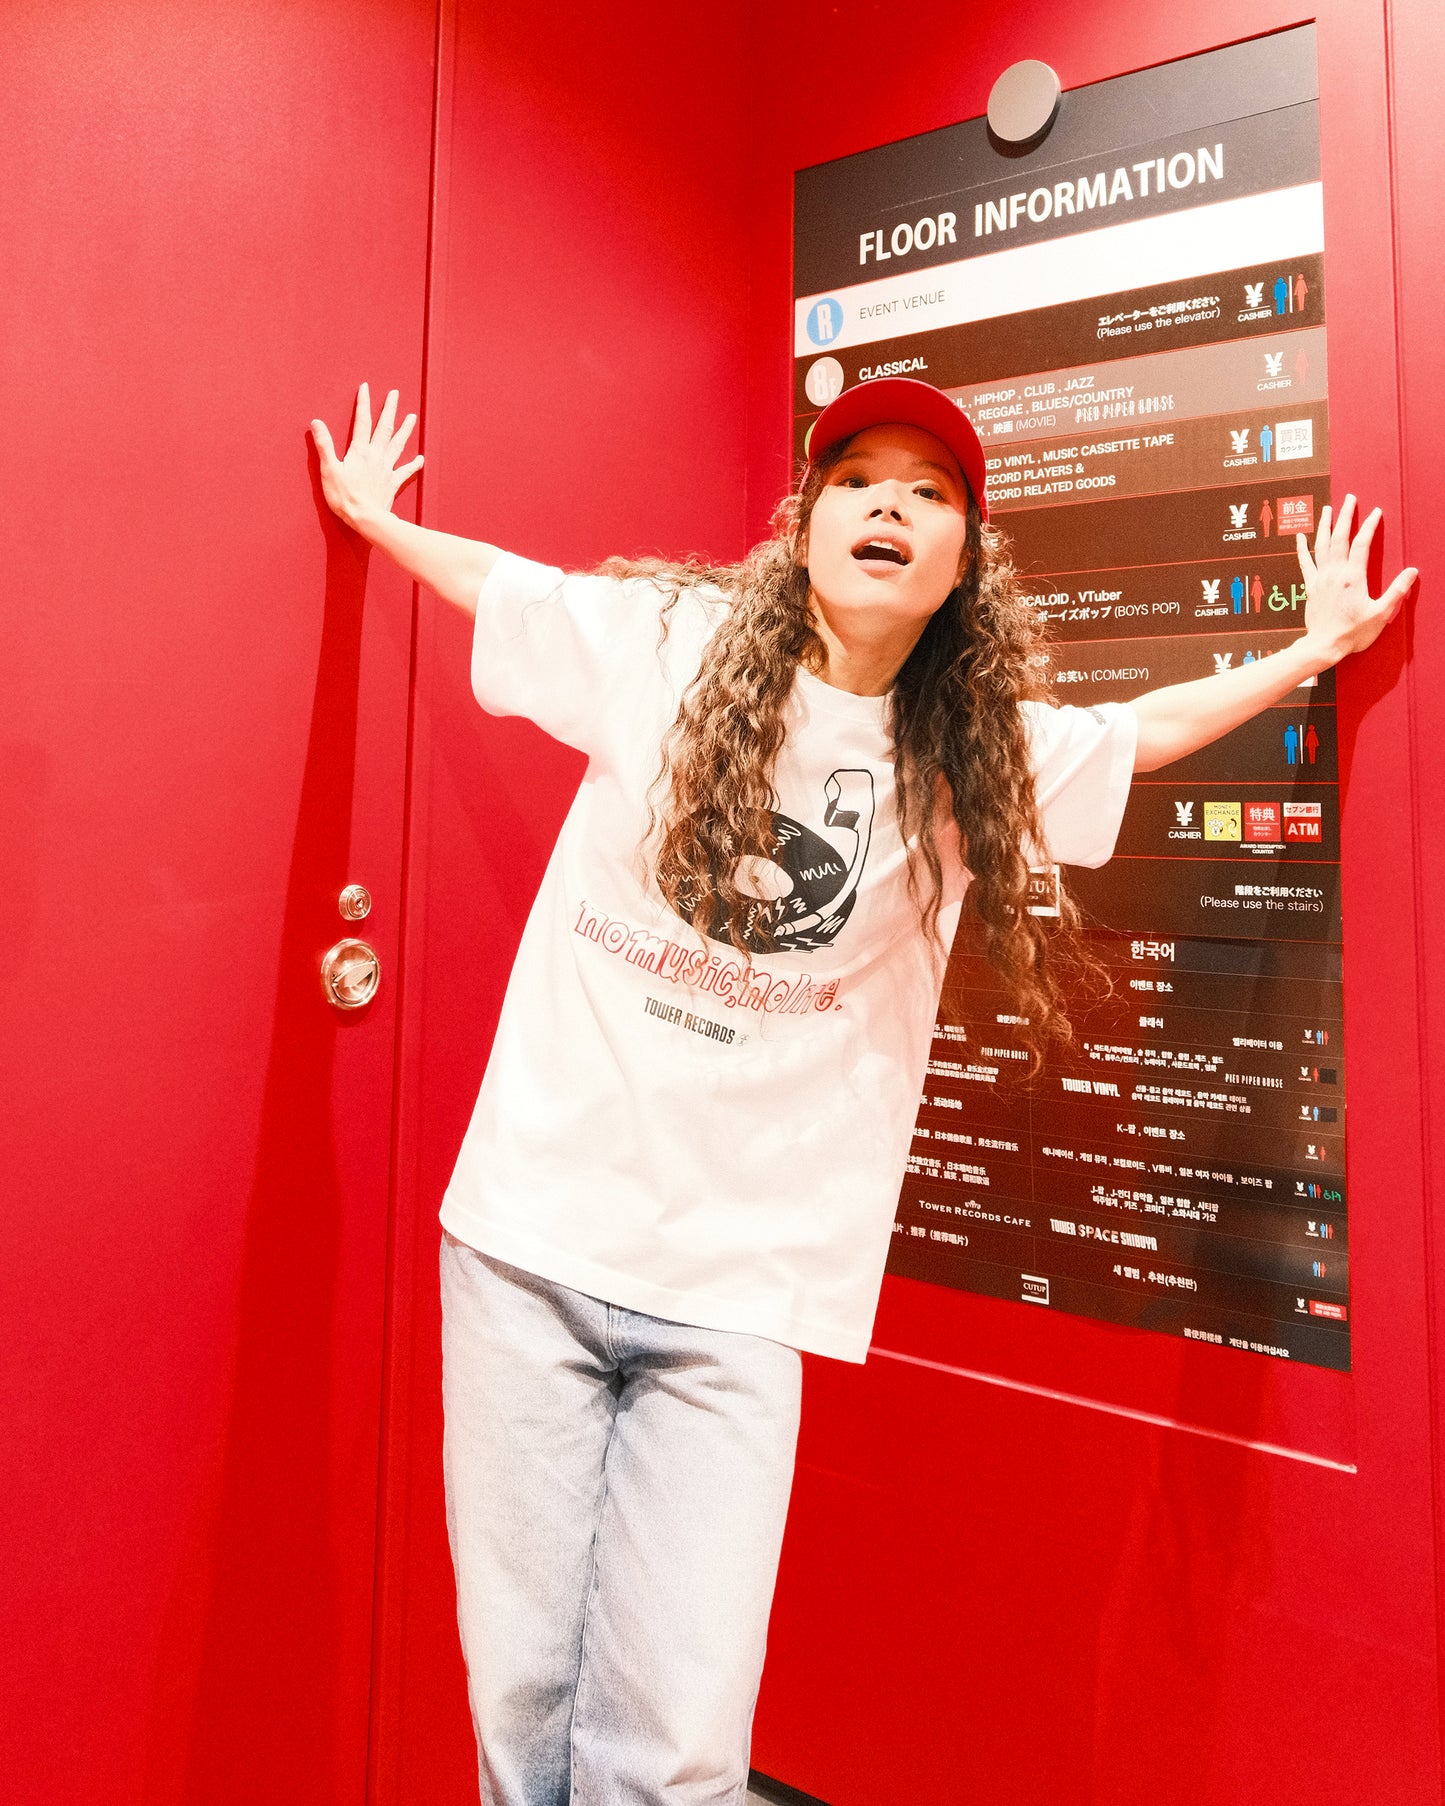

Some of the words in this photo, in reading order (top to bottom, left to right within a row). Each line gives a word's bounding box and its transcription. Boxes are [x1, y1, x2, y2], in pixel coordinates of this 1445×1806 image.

[859, 212, 957, 265] FLOOR
[974, 143, 1224, 237] INFORMATION
[859, 300, 899, 320] EVENT
[903, 290, 945, 310] VENUE
[1098, 295, 1220, 326] エレベーターをご利用ください
[817, 303, 833, 341] R
[1096, 323, 1132, 339] (Please
[1135, 321, 1153, 332] use
[1156, 317, 1173, 329] the
[1174, 307, 1221, 325] elevator)
[1237, 309, 1273, 323] CASHIER
[859, 357, 928, 381] CLASSICAL
[974, 389, 1016, 406] HIPHOP
[1024, 382, 1055, 397] CLUB
[1064, 376, 1095, 392] JAZZ
[1257, 379, 1292, 392] CASHIER
[978, 404, 1023, 421] REGGAE
[1032, 386, 1135, 412] BLUES/COUNTRY
[1138, 394, 1176, 416] HOUSE
[993, 421, 1013, 434] 映画
[1015, 414, 1056, 432] (MOVIE)
[1280, 428, 1308, 444] 買取
[1003, 453, 1035, 468] VINYL
[1043, 447, 1079, 462] MUSIC
[1081, 438, 1140, 457] CASSETTE
[1142, 433, 1175, 448] TAPE
[1280, 444, 1309, 453] カウンター
[1223, 456, 1258, 468] CASHIER
[986, 471, 1022, 486] ECORD
[1023, 464, 1073, 481] PLAYERS
[1075, 462, 1085, 474] &
[986, 487, 1022, 501] ECORD
[1024, 480, 1073, 497] RELATED
[1075, 475, 1116, 489] GOODS
[1282, 500, 1307, 515] 前金
[1222, 531, 1257, 542] CASHIER
[1016, 592, 1069, 608] OCALOID
[1078, 590, 1123, 604] VTuber
[1037, 605, 1112, 623] ボーイズポップ
[1114, 603, 1149, 619] (BOYS
[1151, 601, 1181, 617] POP)
[1194, 607, 1229, 618] CASHIER
[1056, 670, 1089, 684] お笑い
[1091, 667, 1150, 684] (COMEDY)
[1250, 807, 1275, 822] 特典
[1285, 806, 1320, 814] セブン銀行
[1168, 830, 1202, 840] CASHIER
[1287, 823, 1319, 836] ATM
[1235, 885, 1323, 898] 階段をご利用ください
[1200, 895, 1240, 909] (Please
[1242, 901, 1262, 910] use
[1266, 899, 1284, 911] the
[1287, 901, 1324, 913] stairs)
[1130, 940, 1175, 962] 한국어
[1129, 979, 1154, 991] 이벤트
[1156, 981, 1174, 993] 장소
[644, 996, 683, 1026] TOWER
[684, 1012, 736, 1046] RECORDS
[1061, 1078, 1092, 1094] TOWER
[1093, 1081, 1121, 1098] VINYL
[1143, 1125, 1167, 1138] 이벤트
[1169, 1128, 1186, 1141] 장소
[1240, 1176, 1263, 1187] 보이즈
[918, 1200, 952, 1214] TOWER
[954, 1206, 1001, 1223] RECORDS
[1003, 1215, 1031, 1228] CAFE
[1050, 1218, 1077, 1236] TOWER
[1077, 1223, 1119, 1244] SPACE
[1120, 1231, 1158, 1251] SHIBUYA
[1023, 1282, 1046, 1293] CUTUP
